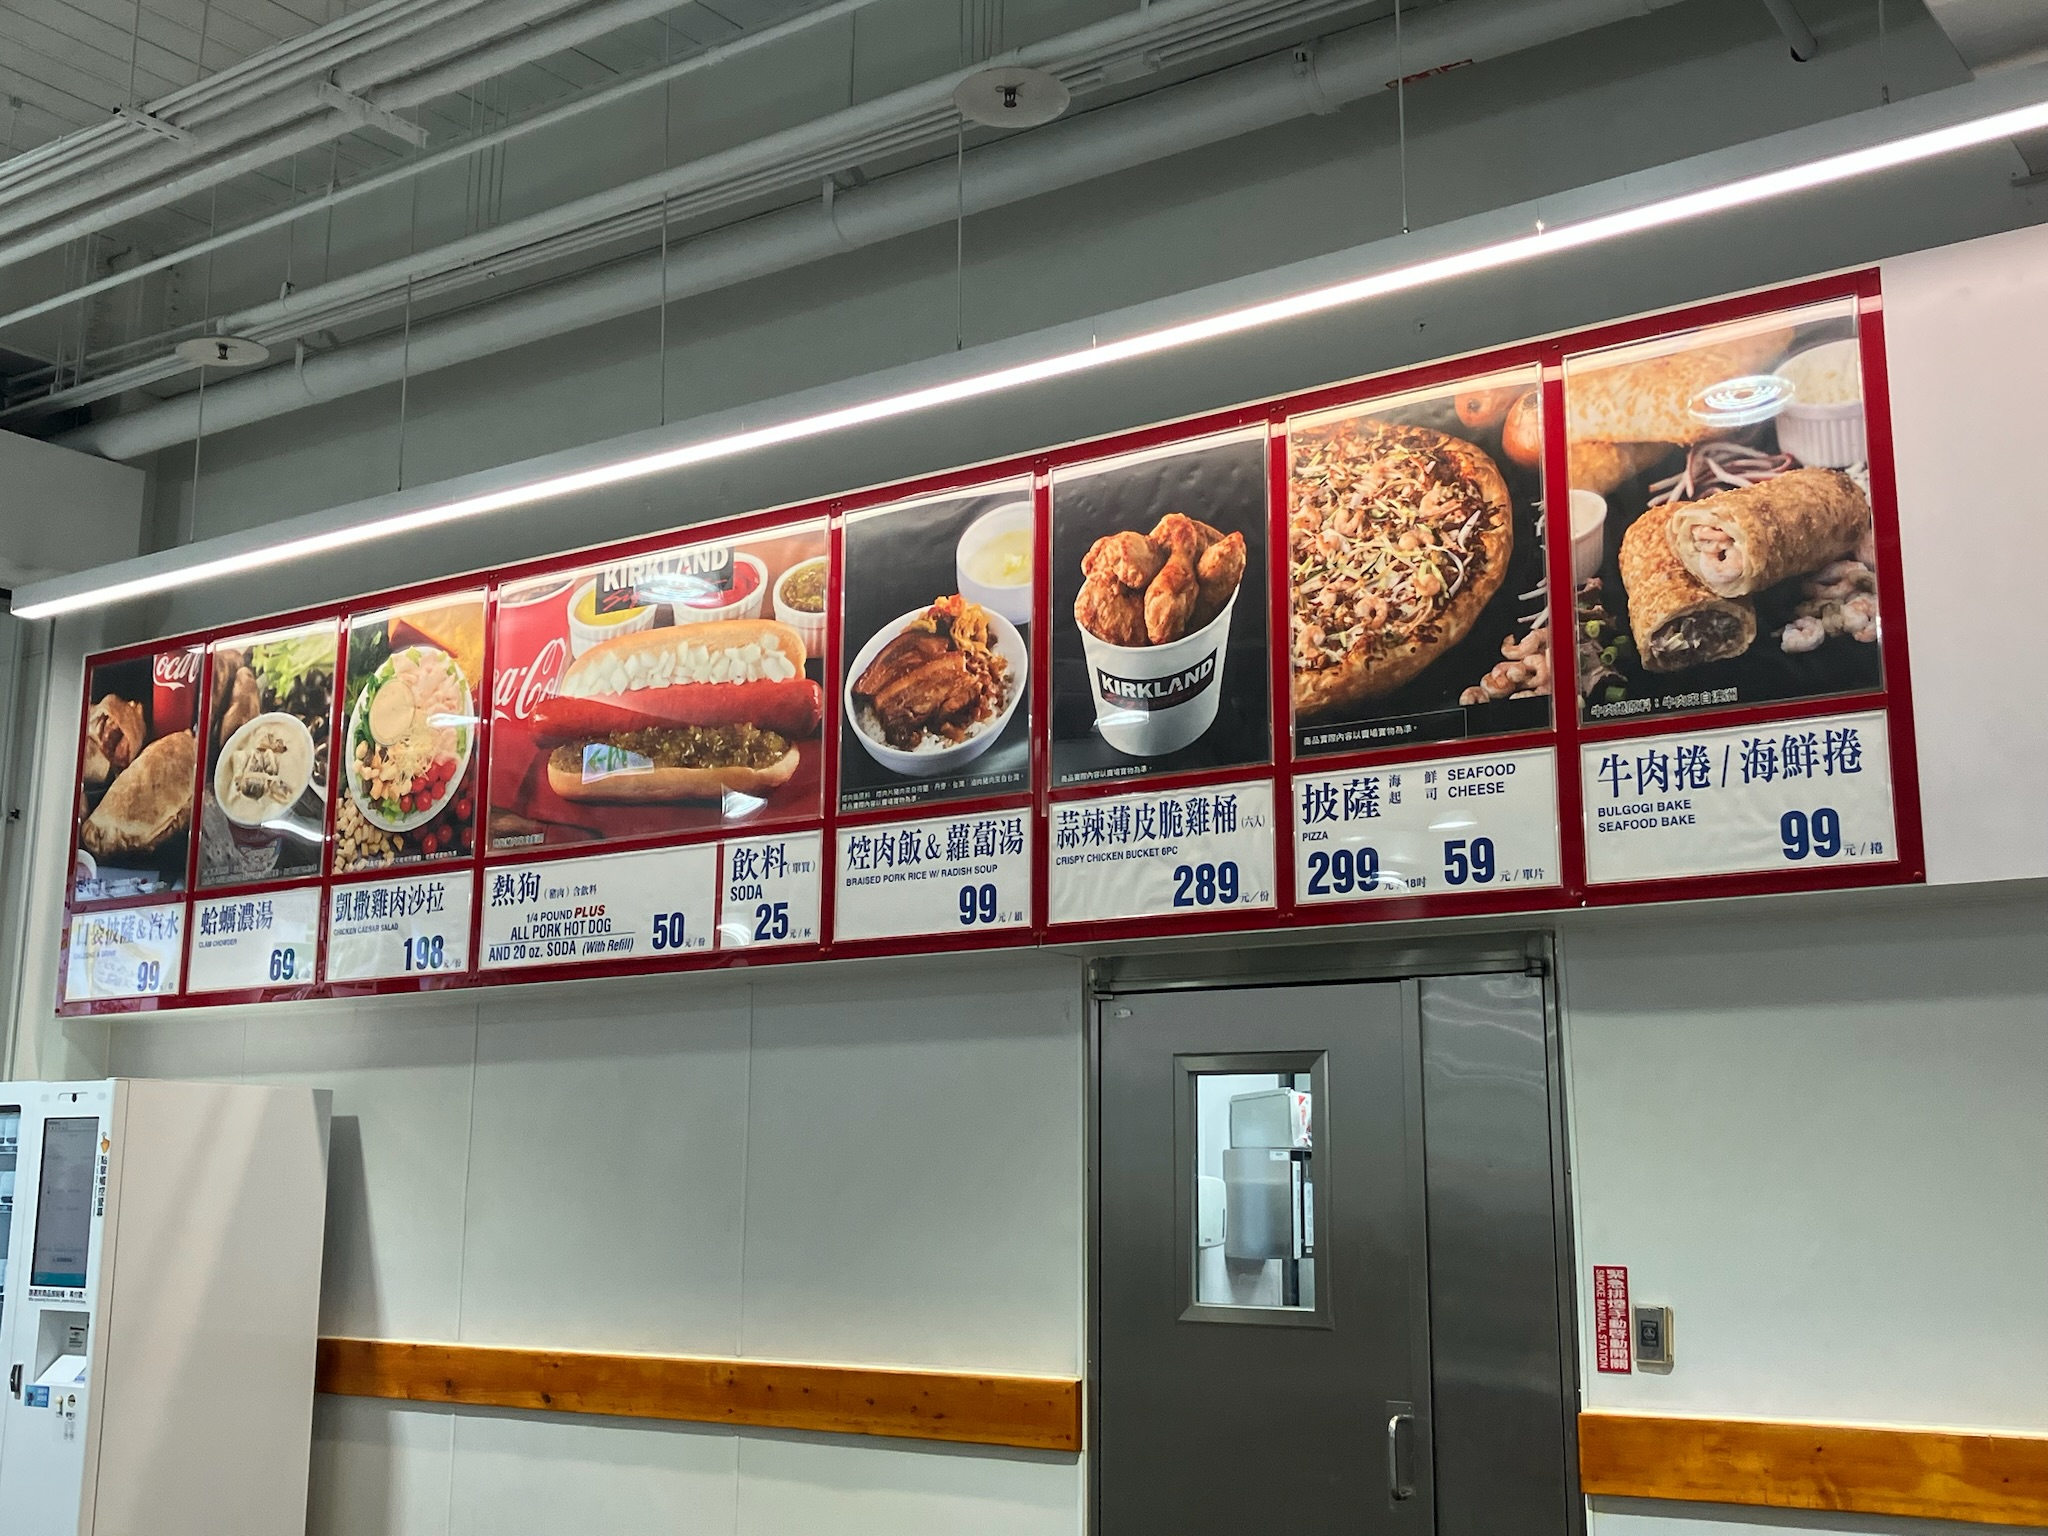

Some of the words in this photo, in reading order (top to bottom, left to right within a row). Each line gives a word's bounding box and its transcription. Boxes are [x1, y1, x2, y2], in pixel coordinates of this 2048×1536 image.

[1101, 658, 1214, 698] KIRKLAND
[1447, 763, 1516, 781] SEAFOOD
[1301, 777, 1381, 825] 披薩
[1448, 781, 1505, 799] CHEESE
[1056, 794, 1238, 850] 蒜辣薄皮脆雞桶
[1598, 803, 1653, 817] BULGOGI
[1656, 799, 1691, 812] BAKE
[1598, 818, 1658, 833] SEAFOOD
[1661, 814, 1696, 828] BAKE
[1302, 831, 1329, 842] PIZZA
[1780, 808, 1841, 860] 99
[732, 843, 787, 882] 飲料
[1056, 854, 1085, 866] CRISPY
[1086, 850, 1124, 863] CHICKEN
[1126, 848, 1160, 860] BUCKET
[1161, 846, 1178, 856] 6PC
[1307, 847, 1380, 896] 299
[1444, 837, 1495, 885] 59
[491, 871, 541, 907] 熱狗
[730, 884, 763, 901] SODA
[846, 875, 881, 887] BRAISED
[883, 873, 906, 883] PORK
[907, 870, 927, 880] RICE
[929, 869, 939, 879] W/
[941, 866, 972, 878] RADISH
[974, 864, 998, 874] SOUP
[1173, 861, 1239, 908] 289
[200, 900, 274, 936] 蛤蠣濃湯
[335, 882, 445, 922] 凱撒雞肉沙拉
[526, 912, 538, 923] 1/4
[540, 909, 573, 921] POUND
[574, 904, 606, 918] PLUS
[959, 883, 997, 925] 99
[357, 924, 381, 934] CAESAR
[381, 922, 399, 931] SALAD
[510, 926, 529, 941] ALL
[532, 922, 562, 939] PORK
[564, 920, 586, 936] HOT
[588, 918, 612, 934] DOG
[652, 912, 685, 950] 50
[754, 902, 789, 941] 25
[269, 947, 295, 981] 69
[403, 935, 444, 971] 198
[488, 946, 511, 962] AND
[513, 944, 526, 959] 20
[528, 946, 543, 958] oz.
[546, 941, 576, 956] SODA
[582, 940, 606, 956] (With
[607, 937, 634, 952] Refill)
[137, 961, 160, 992] 99
[1595, 1269, 1606, 1298] SMOKE
[1596, 1299, 1607, 1333] MANUAL
[1598, 1334, 1609, 1369] STATION
